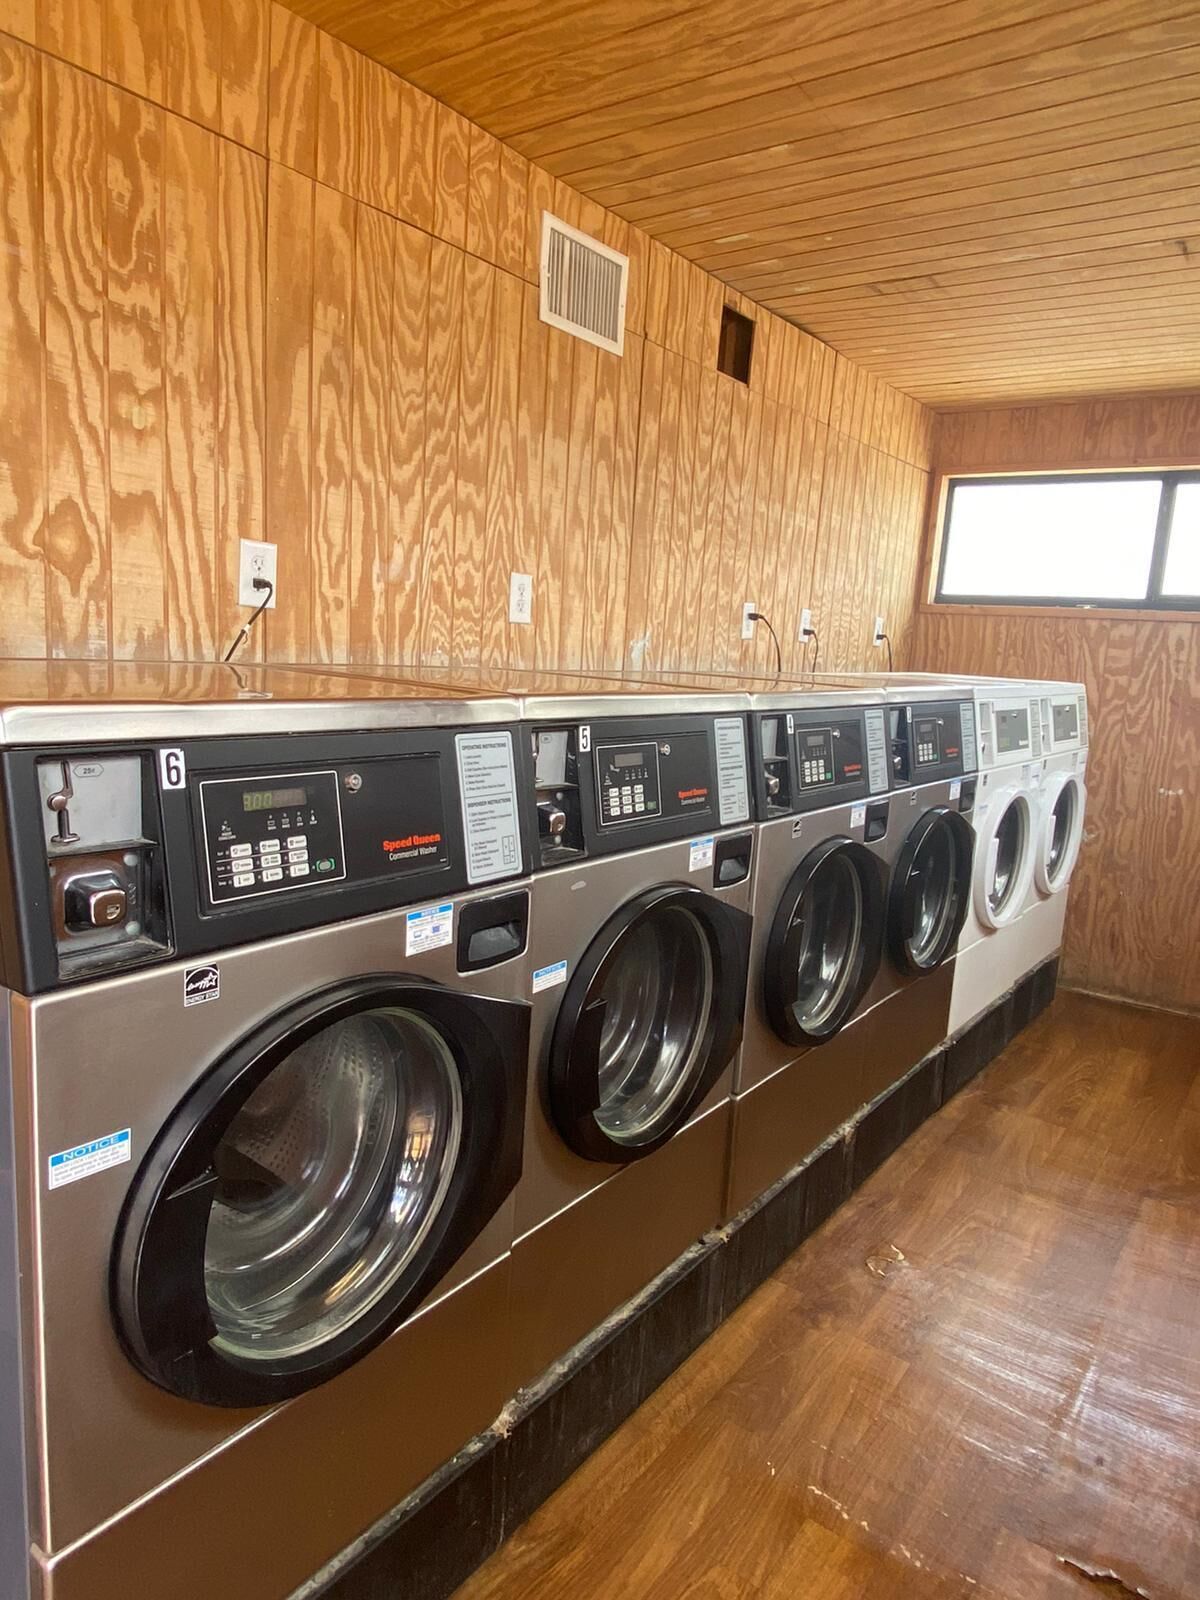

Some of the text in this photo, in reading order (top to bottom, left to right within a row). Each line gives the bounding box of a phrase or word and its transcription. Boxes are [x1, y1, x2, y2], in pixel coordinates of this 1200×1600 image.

[581, 727, 588, 750] 5
[165, 752, 182, 786] 6
[383, 834, 441, 851] Speed Queen
[389, 846, 437, 861] Commercial Washer
[62, 1134, 120, 1162] NOTICE
